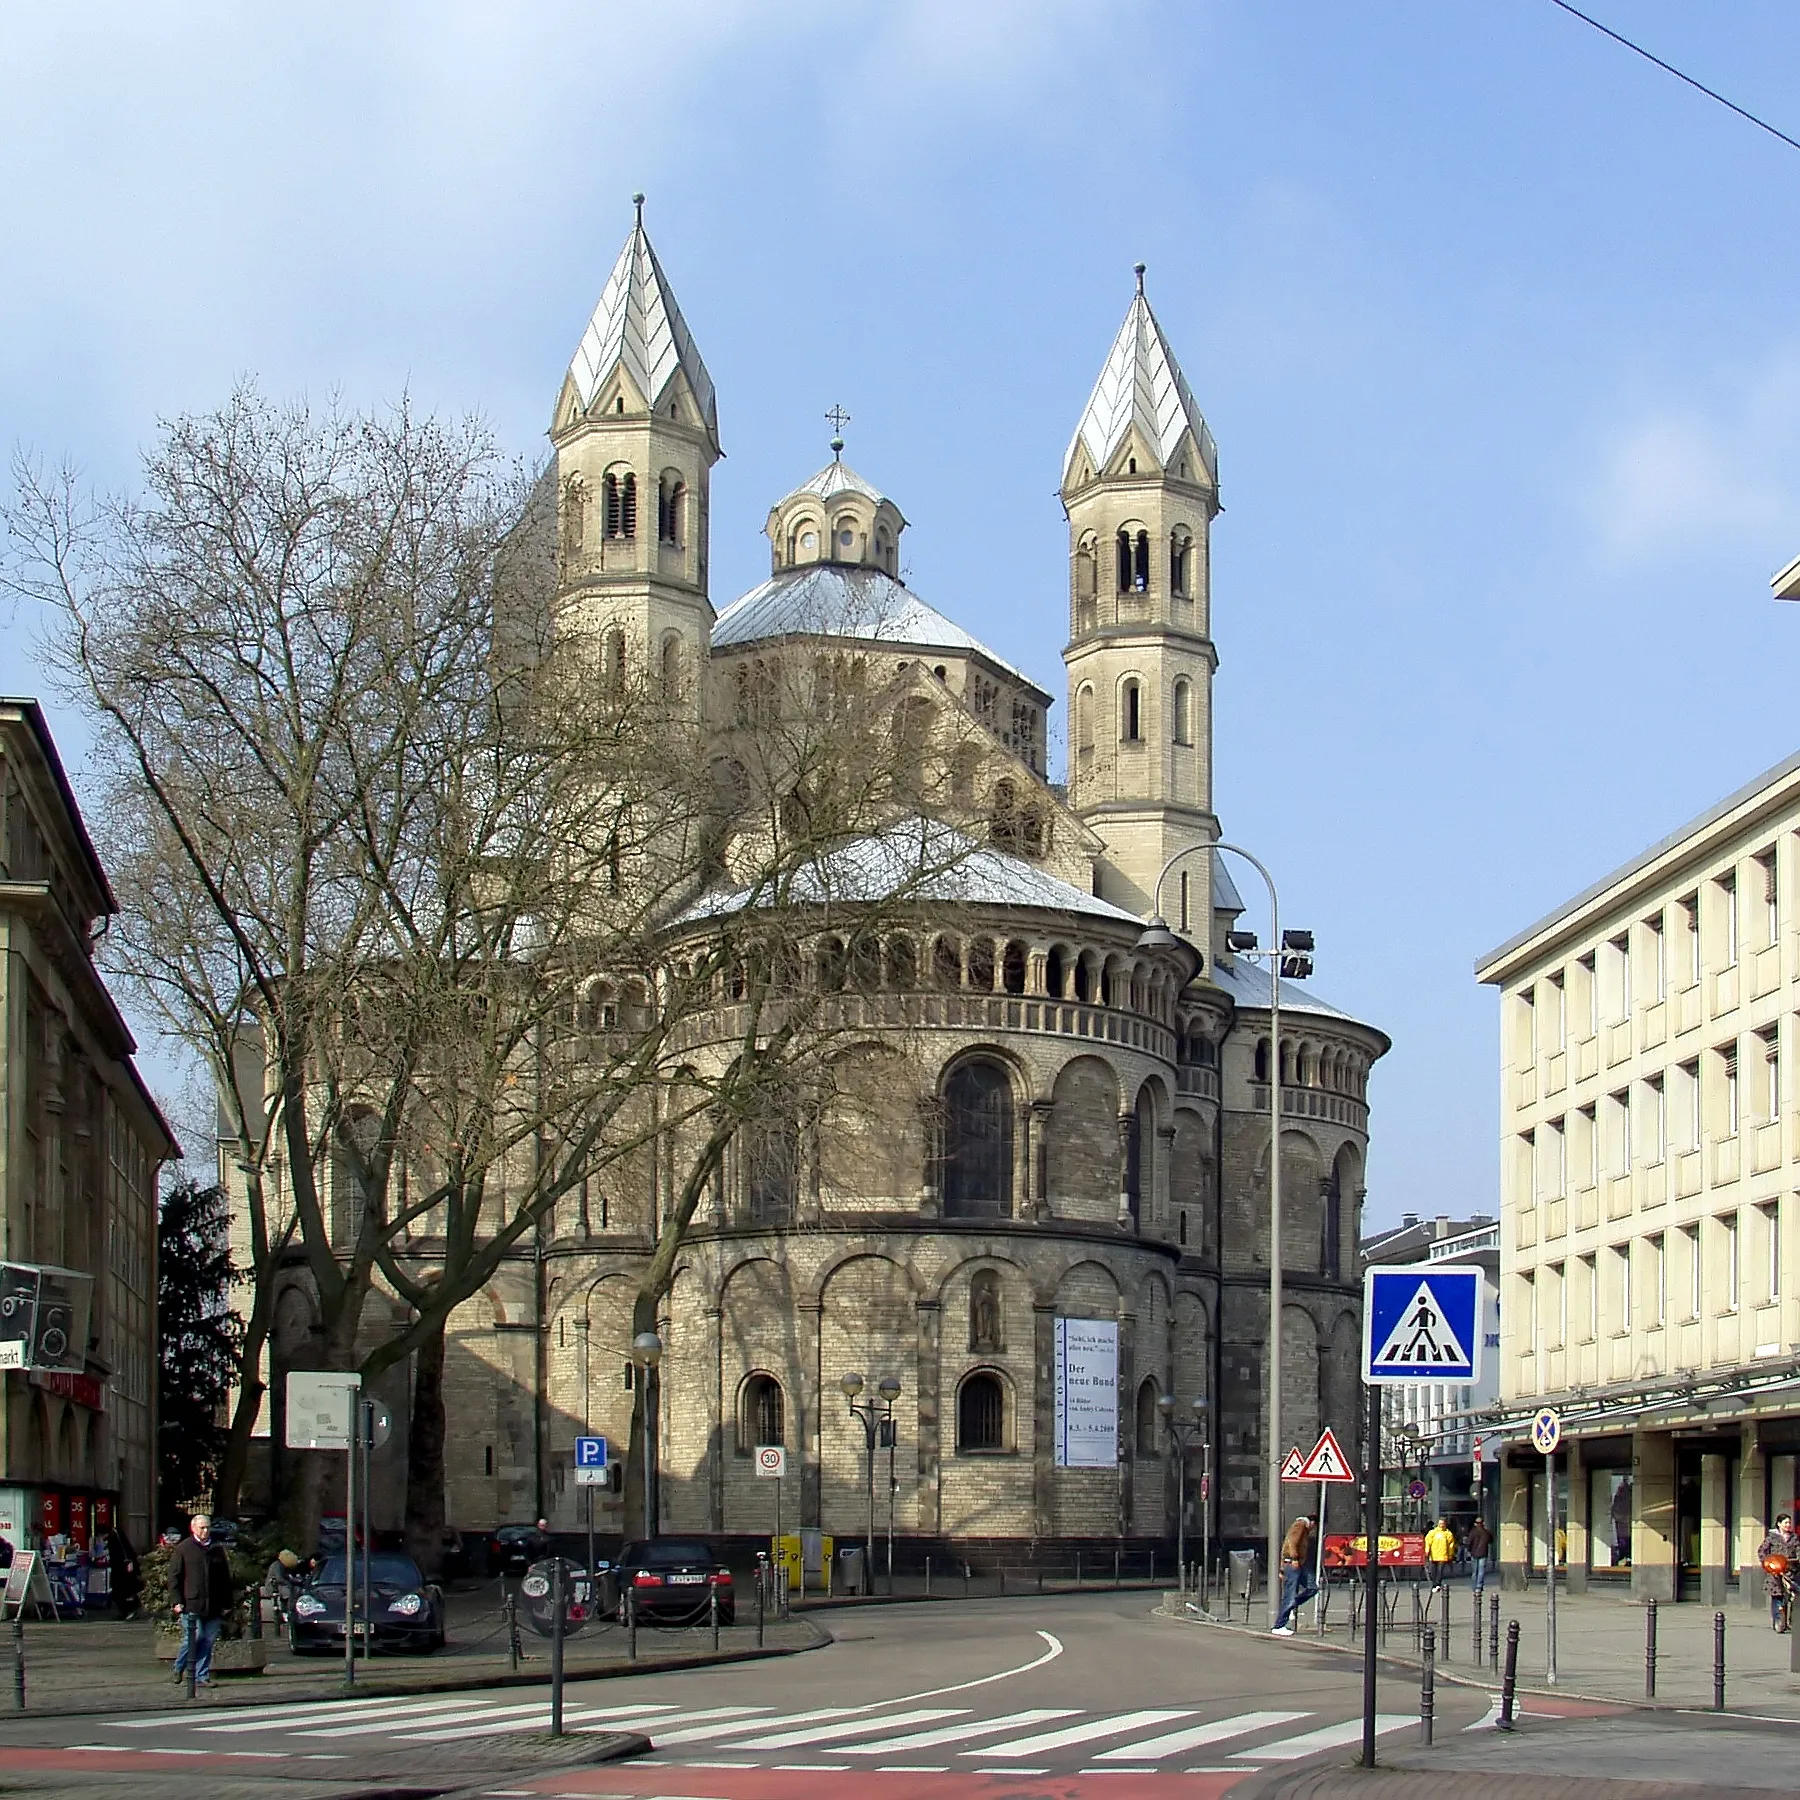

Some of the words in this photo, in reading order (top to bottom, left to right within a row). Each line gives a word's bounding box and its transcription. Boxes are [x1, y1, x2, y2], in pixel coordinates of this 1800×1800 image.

[1069, 1363, 1085, 1373] Der
[1069, 1377, 1089, 1386] neue
[583, 1441, 599, 1463] P
[765, 1454, 776, 1463] 30
